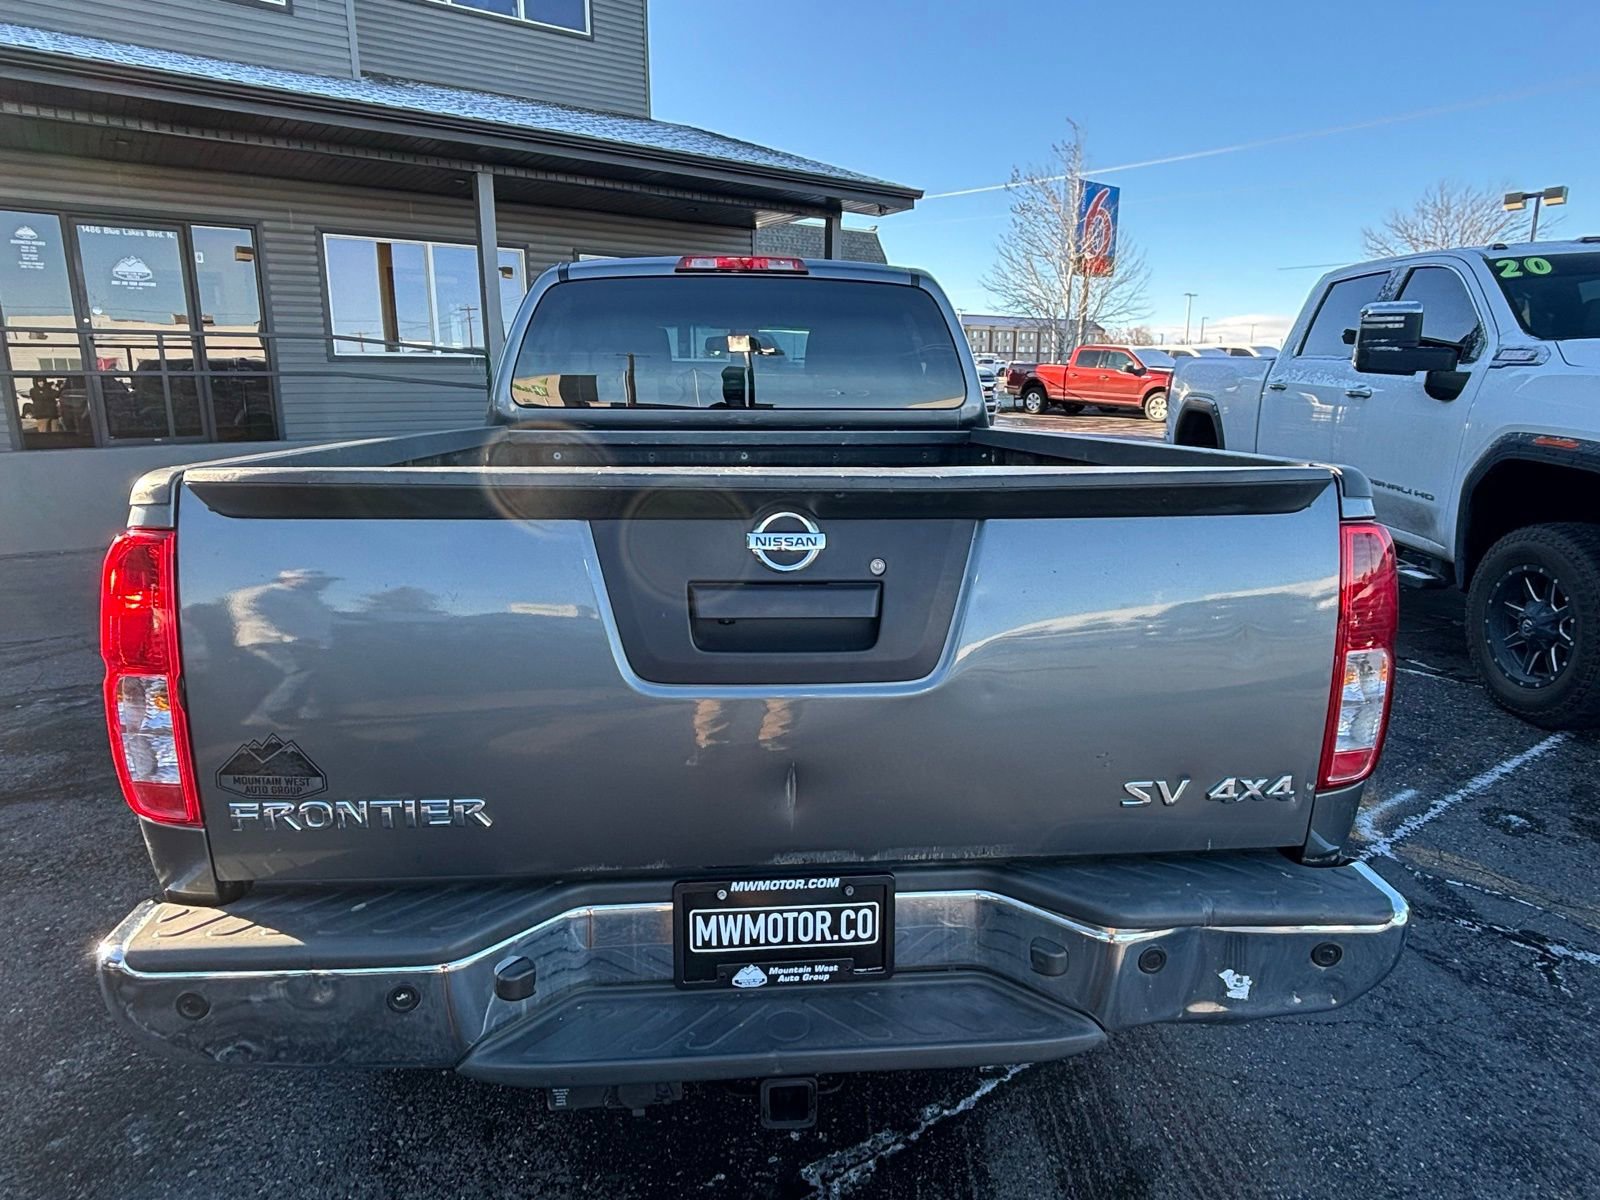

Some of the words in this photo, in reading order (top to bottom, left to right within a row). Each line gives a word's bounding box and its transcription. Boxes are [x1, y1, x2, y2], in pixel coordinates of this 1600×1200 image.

[1084, 187, 1113, 260] 6
[103, 227, 121, 236] Blue
[122, 228, 145, 237] Lakes
[1495, 257, 1552, 278] 20
[1414, 490, 1435, 501] HD
[755, 536, 818, 547] NISSAN
[232, 776, 282, 786] MOUNTAIN
[284, 777, 311, 787] WEST
[244, 785, 269, 795] AUTO
[271, 786, 303, 795] GROUP
[1120, 779, 1191, 807] SV
[228, 799, 493, 831] FRONTIER
[730, 877, 840, 892] MWMOTOR.COM
[695, 908, 873, 947] MWMOTOR.CO
[768, 966, 812, 976] Mountain
[814, 964, 839, 973] West
[777, 974, 800, 983] Auto
[802, 973, 830, 982] Group
